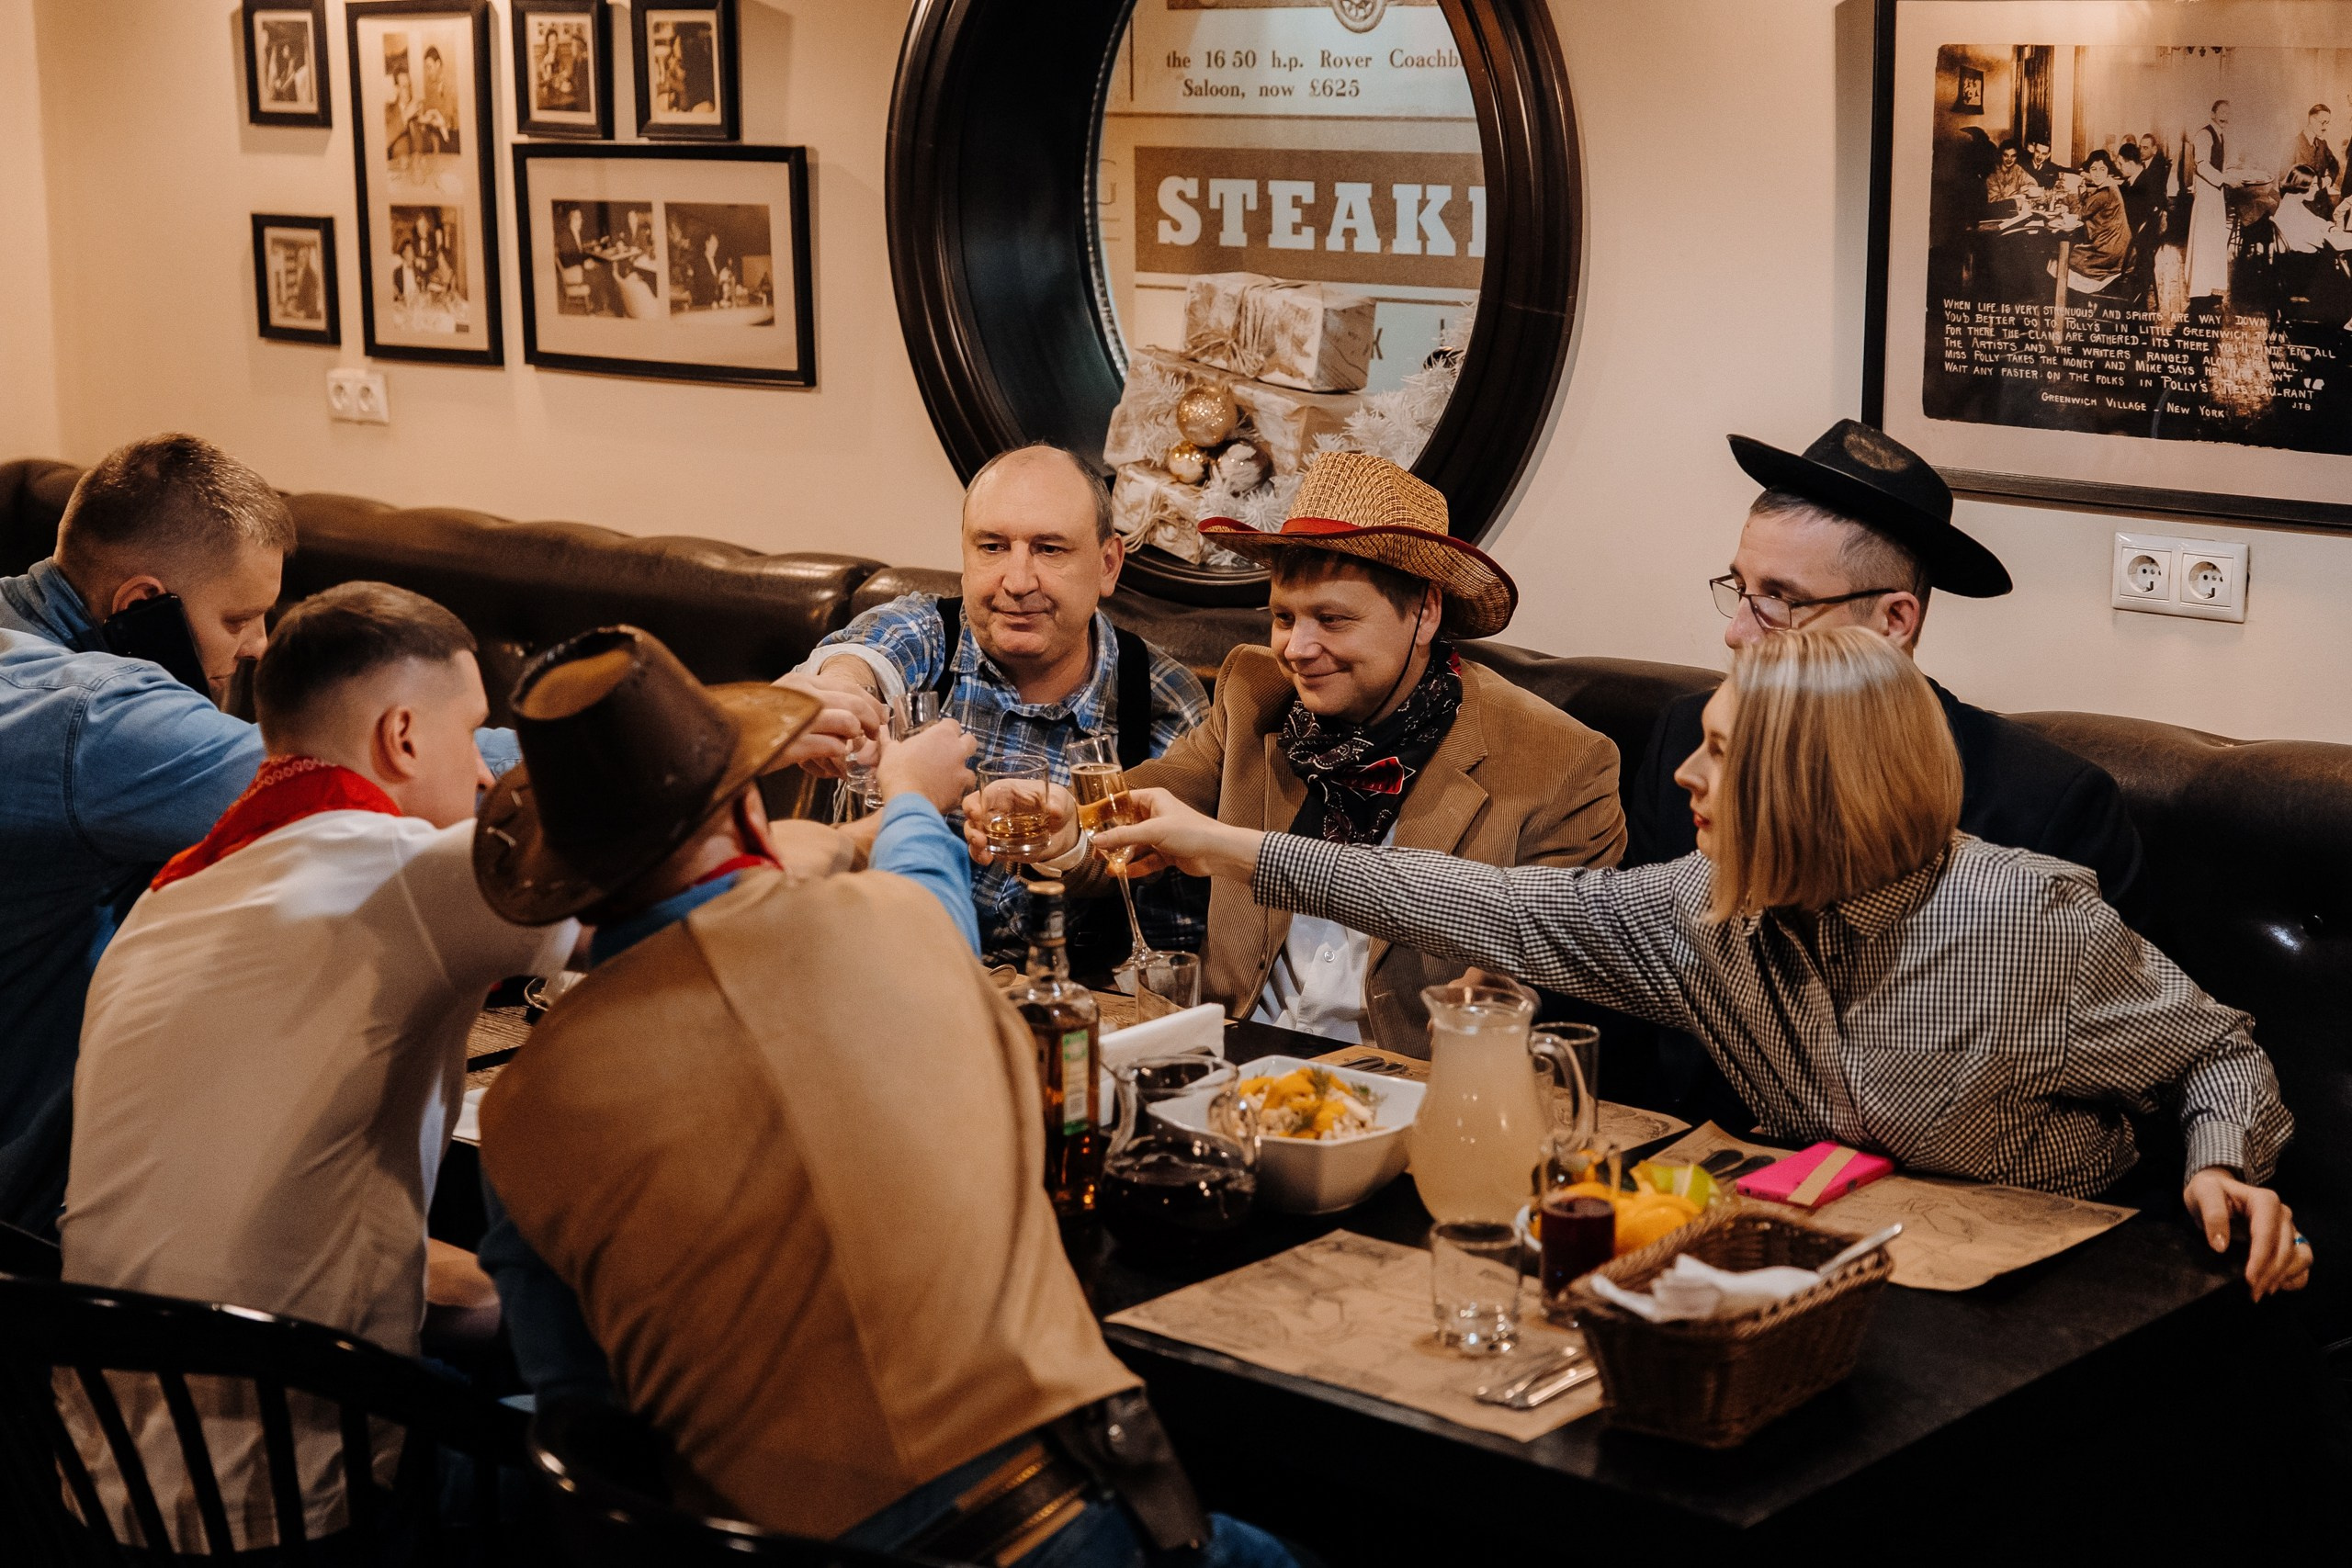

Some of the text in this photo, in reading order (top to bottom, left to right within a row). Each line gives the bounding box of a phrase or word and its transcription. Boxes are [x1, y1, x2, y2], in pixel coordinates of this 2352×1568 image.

[1166, 50, 1192, 69] the
[1271, 50, 1304, 72] h.p.
[1320, 49, 1373, 69] Rover
[1182, 78, 1360, 100] Saloon, now £625
[1944, 299, 2267, 328] WHEN LIFE IS VERY STRENUOUS AND SPIRITS ARE WAY DOWN
[1945, 310, 1970, 323] YOU'D
[1975, 314, 2016, 325] BETTER
[2024, 317, 2038, 328] GO
[2044, 318, 2056, 328] TO
[2115, 323, 2129, 333] IN
[2139, 325, 2174, 336] LITTLE
[2182, 326, 2248, 340] GREENWICH
[2256, 330, 2288, 344] TOWN
[1944, 337, 1962, 349] THE
[1972, 337, 2017, 351] ARTISTS
[2025, 343, 2046, 354] AND
[2054, 345, 2073, 355] THE
[2082, 347, 2132, 359] WRITERS
[2146, 351, 2189, 364] RANGED
[1945, 324, 1962, 335] FOR
[1967, 326, 1996, 337] THERE
[2002, 328, 2019, 339] THE
[2028, 330, 2061, 341] CLANS
[2065, 332, 2085, 342] ARE
[2090, 333, 2139, 345] GATHERED
[2152, 337, 2170, 348] ITS
[2175, 339, 2210, 352] THERE
[2314, 348, 2336, 359] ALL
[1944, 361, 1968, 373] WAIT
[1973, 366, 1994, 376] ANY
[2001, 367, 2038, 379] FASTER
[2047, 371, 2061, 380] ON
[2069, 372, 2089, 382] THE
[2096, 375, 2125, 386] FOLKS
[2140, 378, 2153, 387] IN
[2161, 376, 2209, 392] POLLY'S
[1945, 350, 1967, 359] MISS
[1974, 350, 2000, 362] POLLY
[2007, 354, 2035, 364] TAKES
[2040, 355, 2058, 365] THE
[2063, 357, 2095, 369] MONEY
[2105, 361, 2126, 371] AND
[2135, 360, 2162, 373] MIKE
[2168, 365, 2195, 376] SAYS
[2205, 367, 2218, 378] HE
[2041, 392, 2097, 406] GREENWICH
[2106, 397, 2147, 411] VILLAGE
[2166, 402, 2190, 414] NEW
[2199, 405, 2225, 418] YORK
